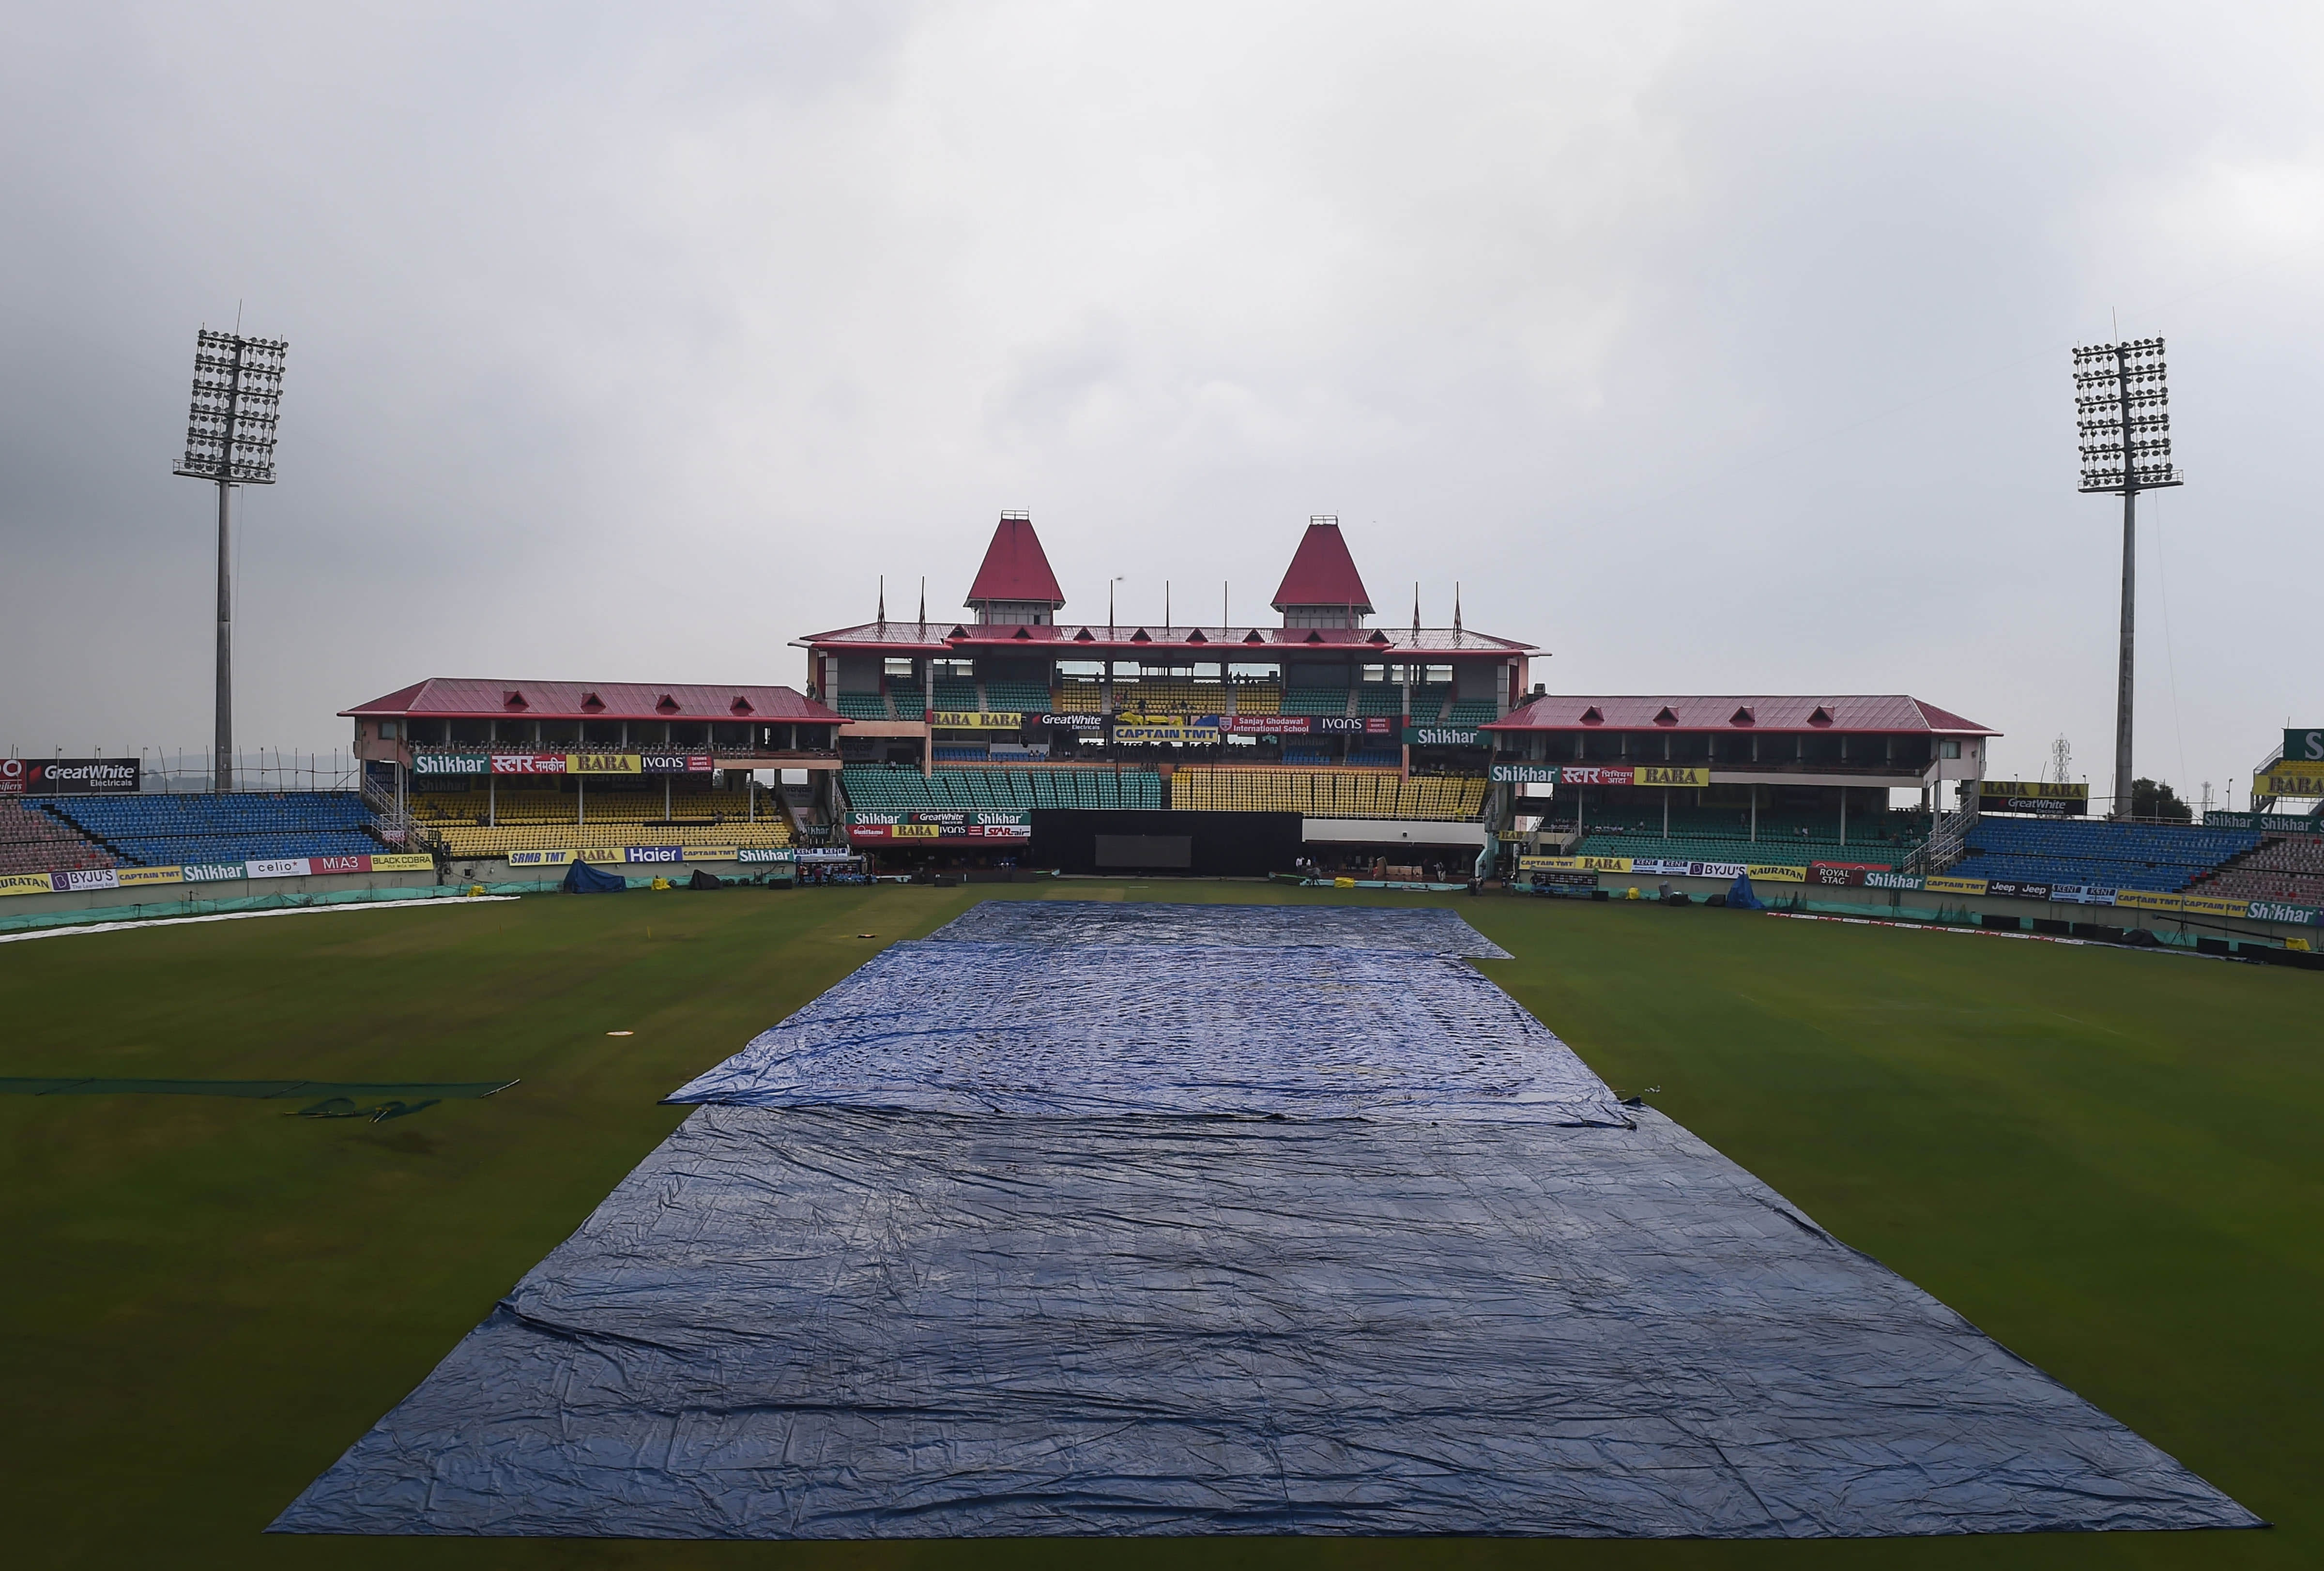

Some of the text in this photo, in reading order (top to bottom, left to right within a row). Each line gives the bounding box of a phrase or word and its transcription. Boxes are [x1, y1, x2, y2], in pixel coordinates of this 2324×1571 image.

[933, 714, 1021, 726] BABA BABA
[1042, 715, 1101, 724] GreatWhite
[1116, 729, 1216, 738] CAPTAIN TMT
[1418, 729, 1477, 744] Shikhar
[417, 756, 484, 773] Shikhar
[535, 757, 566, 772] नमकीन
[576, 755, 632, 771] BABA
[45, 765, 135, 779] GreatWhite
[1493, 766, 1555, 782] Shikhar
[1644, 768, 1698, 784] BABA
[1984, 782, 2083, 797] BABA BABA
[2267, 776, 2324, 793] BABA
[2008, 798, 2066, 809] GreatWhite
[855, 813, 900, 824] Shikhar
[977, 813, 1022, 824] Shikhar
[2204, 814, 2253, 828] Shikhar
[2261, 817, 2311, 831] Shikhar
[898, 825, 933, 836] BABA
[511, 852, 566, 863] SRMB TMT
[576, 849, 617, 861] BABA
[630, 847, 676, 862] Haier
[739, 850, 791, 862] Shikhar
[258, 862, 291, 872] celio
[322, 856, 358, 869] Mi A3
[1584, 857, 1623, 870] BABA
[119, 872, 159, 880] CAPTAIN
[184, 865, 243, 881] Shikhar
[1705, 865, 1745, 875] BYJU'S
[1750, 867, 1804, 881] NAURATAN
[1819, 869, 1850, 877] ROYAL
[0, 877, 49, 889] URATAN
[70, 870, 113, 884] BYJU'S
[1821, 876, 1845, 885] STAG
[1865, 873, 1922, 889] Shikhar
[1927, 880, 1964, 888] CAPTAIN
[1992, 882, 2015, 892] Jeep
[2022, 885, 2046, 895] Jeep
[2118, 895, 2158, 904] CAPTAIN
[2184, 900, 2248, 912] CAPTAIN TMT
[2248, 902, 2313, 923] Shikhar
